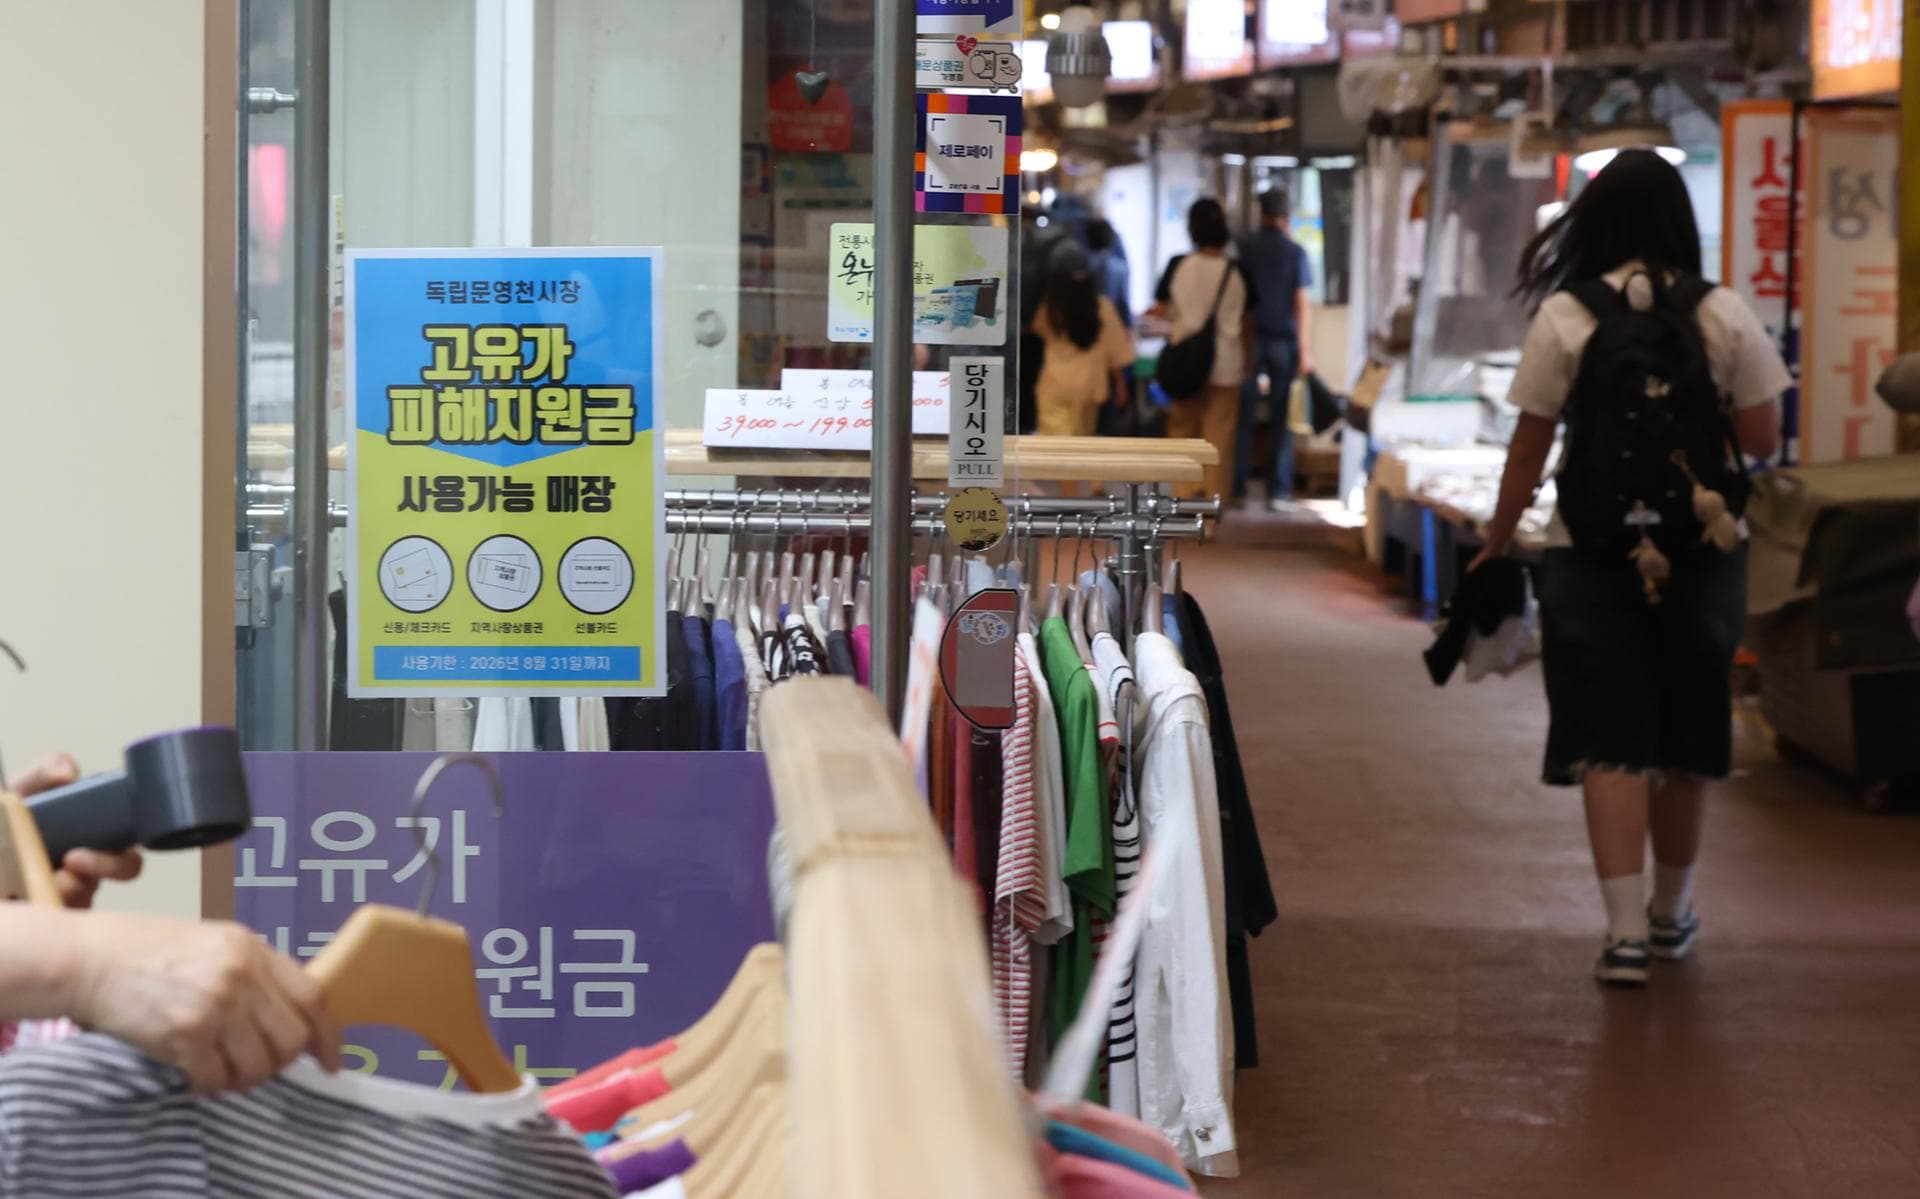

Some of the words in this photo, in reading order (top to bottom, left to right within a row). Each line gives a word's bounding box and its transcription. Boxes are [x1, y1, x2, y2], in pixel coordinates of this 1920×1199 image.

[939, 144, 993, 159] 제로페이
[839, 234, 874, 250] 전통시
[837, 251, 875, 288] 온누
[425, 280, 581, 304] 독립문영천시장
[857, 290, 875, 306] 가
[421, 323, 576, 382] 고유가
[912, 397, 944, 406] 000
[386, 384, 637, 445] 피해지원금
[964, 364, 989, 456] 당기시오
[957, 463, 995, 475] PULL
[397, 475, 536, 513] 사용가능
[546, 475, 616, 514] 매장
[953, 509, 999, 523] 당기세요
[383, 622, 452, 634] 신용/체크카드
[470, 622, 544, 634] 지역사랑상품권
[575, 622, 618, 634] 선불카드
[401, 656, 457, 671] 사용기한
[469, 656, 521, 671] 2026년
[523, 656, 547, 671] 8월
[551, 655, 611, 671] 31일까지
[233, 809, 481, 904] 고유가
